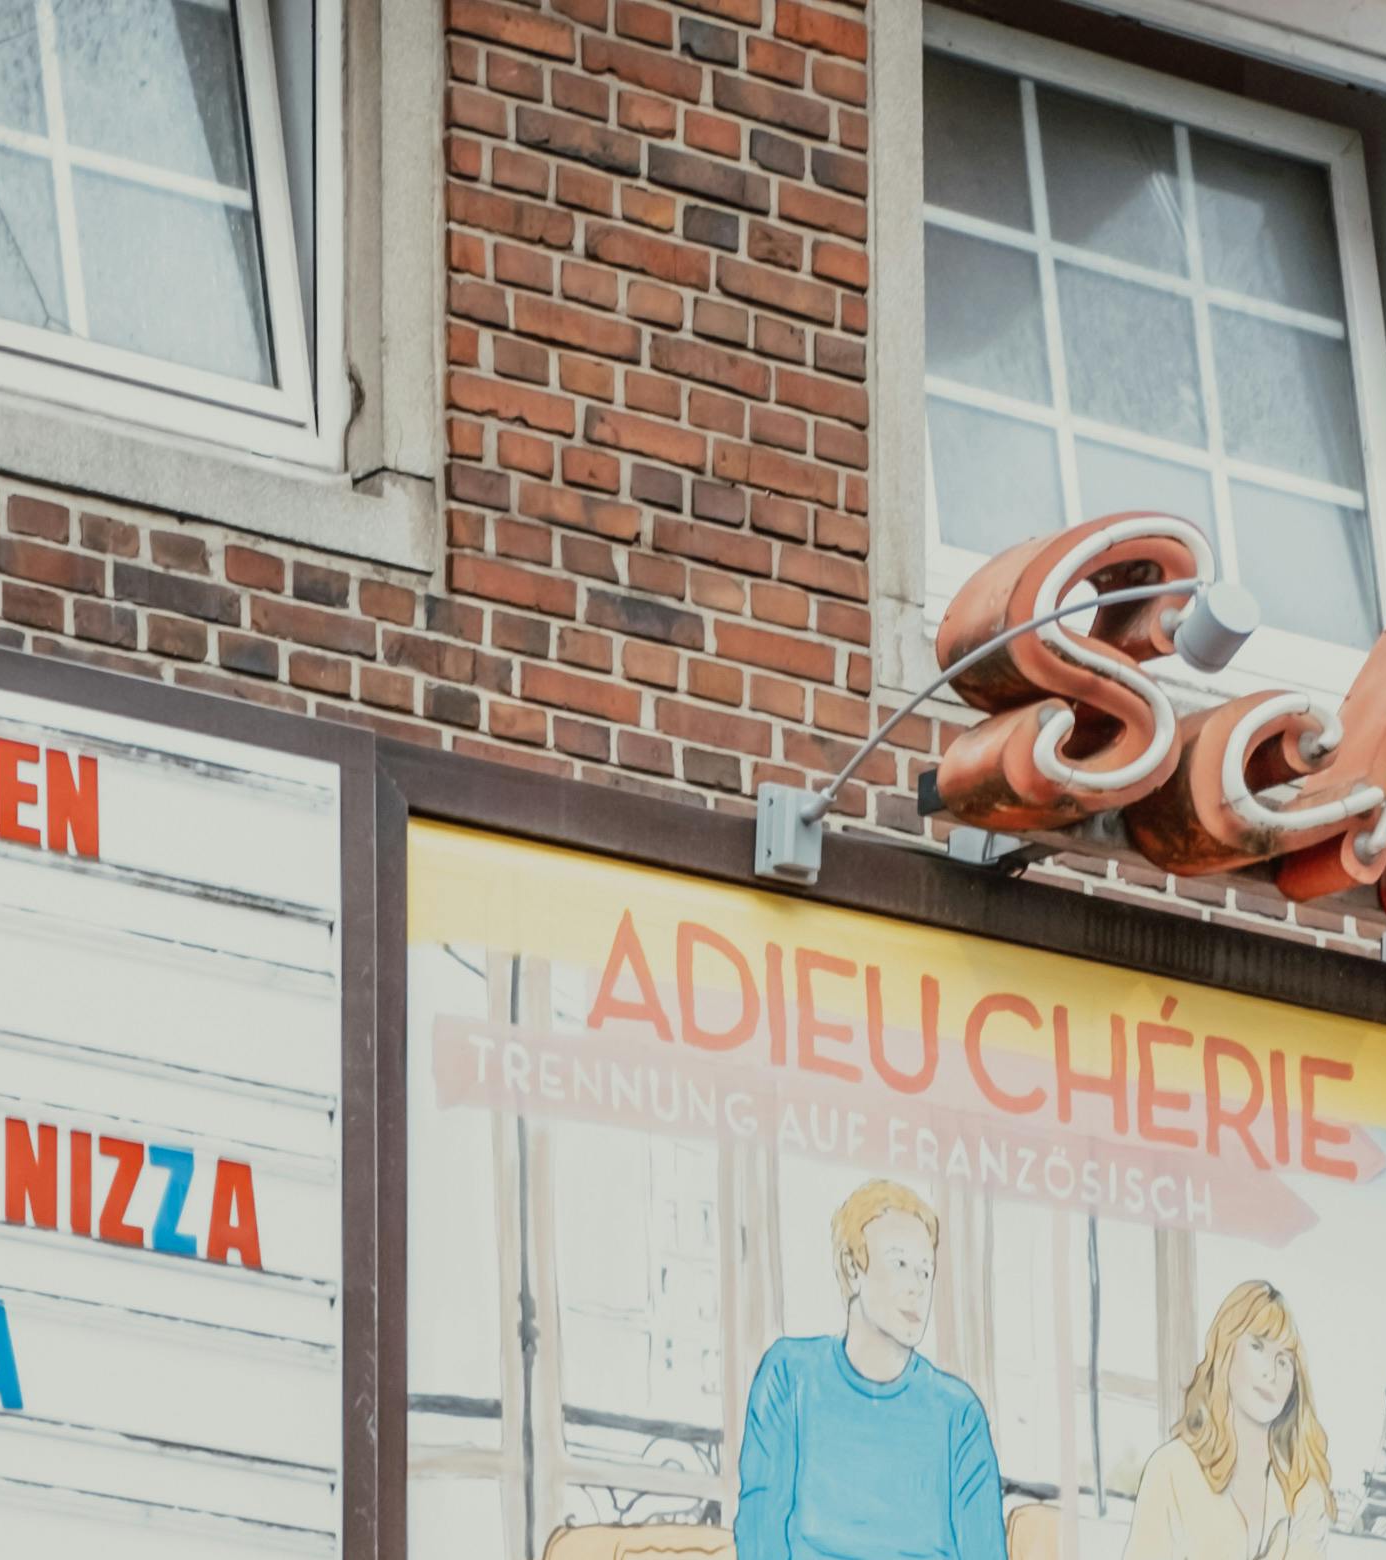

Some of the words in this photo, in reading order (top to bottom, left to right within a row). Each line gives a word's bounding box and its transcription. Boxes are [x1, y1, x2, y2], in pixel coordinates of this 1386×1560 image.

[468, 1035, 758, 1137] TRENNUNG
[778, 1104, 865, 1160] AUF
[889, 1116, 1215, 1227] FRANZÖSISCH
[587, 909, 940, 1093] ADIEU
[964, 993, 1359, 1181] CHÉRIE
[6, 1119, 261, 1267] NIZZA
